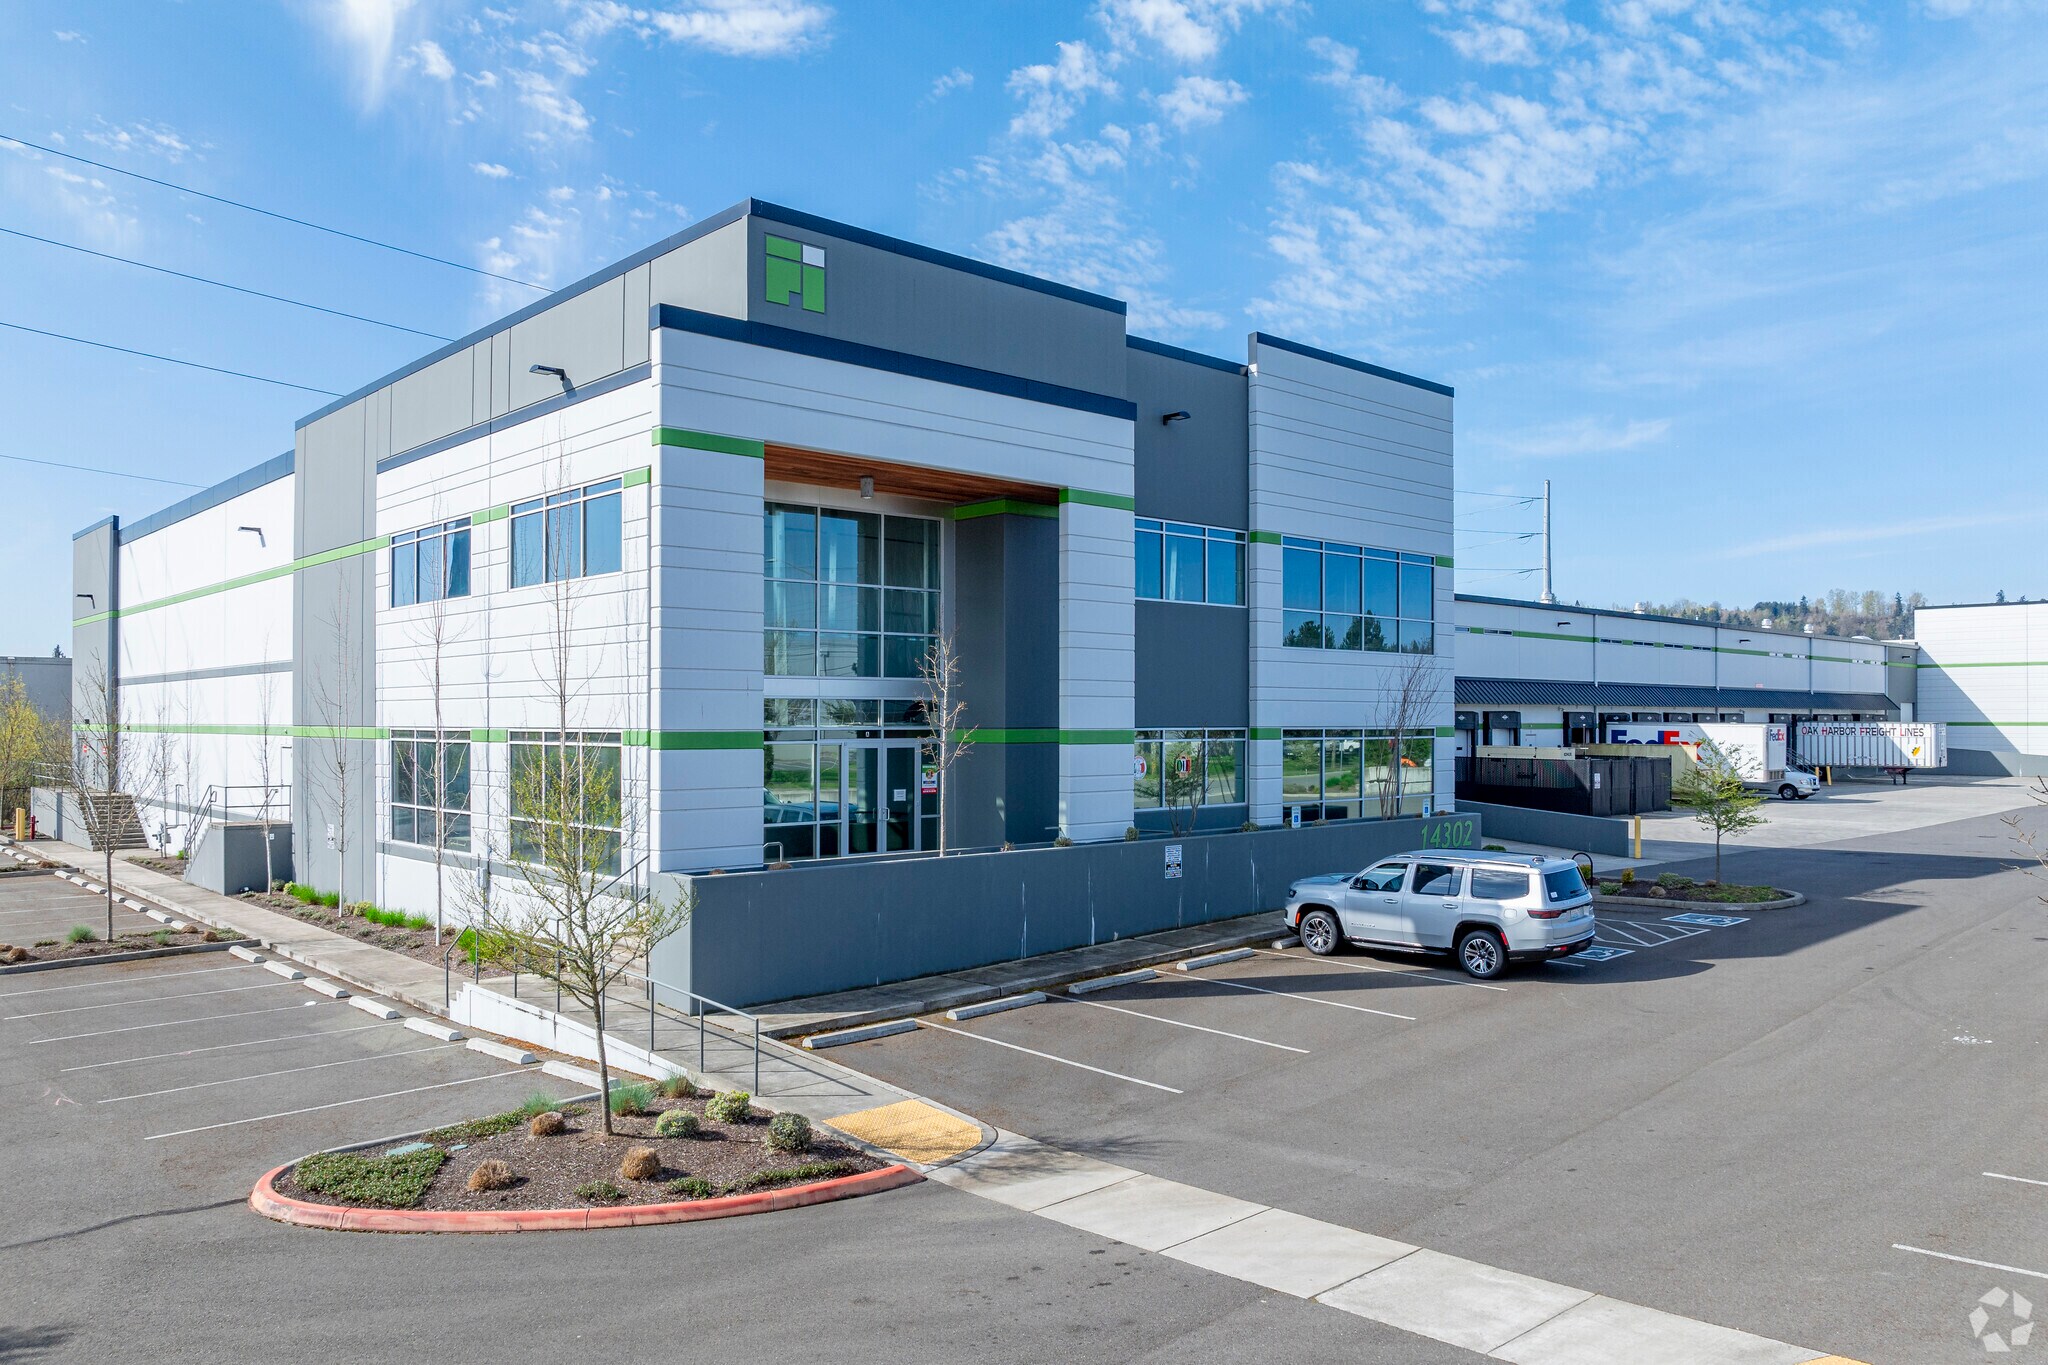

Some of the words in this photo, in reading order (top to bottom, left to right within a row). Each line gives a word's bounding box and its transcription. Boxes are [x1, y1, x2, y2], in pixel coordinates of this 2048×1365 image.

[1769, 728, 1785, 741] FedEx
[1801, 726, 1818, 735] OAK
[1821, 726, 1856, 736] HARBOR
[1859, 727, 1897, 737] FREIGHT
[1899, 727, 1924, 737] LINES
[1421, 820, 1473, 849] 14302
